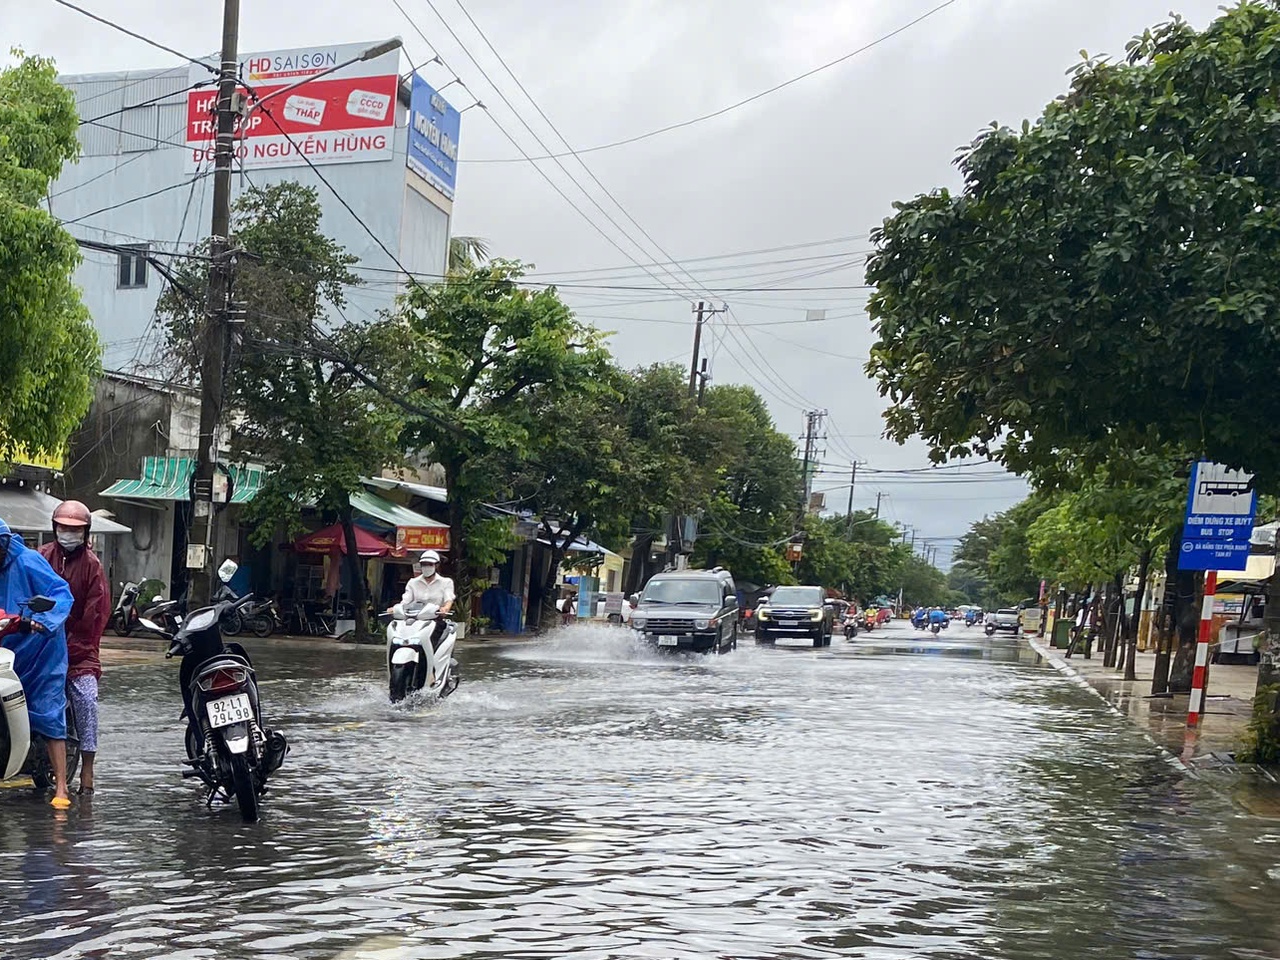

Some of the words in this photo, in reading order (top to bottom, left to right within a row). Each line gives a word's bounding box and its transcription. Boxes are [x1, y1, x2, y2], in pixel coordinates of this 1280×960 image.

[249, 58, 271, 73] HD
[274, 51, 337, 71] SAISON
[360, 99, 384, 109] CCCD
[295, 106, 320, 120] THẤP
[254, 134, 327, 158] NGUYỄN
[333, 133, 386, 152] HÙNG
[1224, 517, 1234, 525] XE
[1200, 528, 1213, 536] BUS
[1218, 528, 1234, 536] STOP
[214, 698, 242, 713] 92-L1
[213, 708, 250, 726] 294.98
